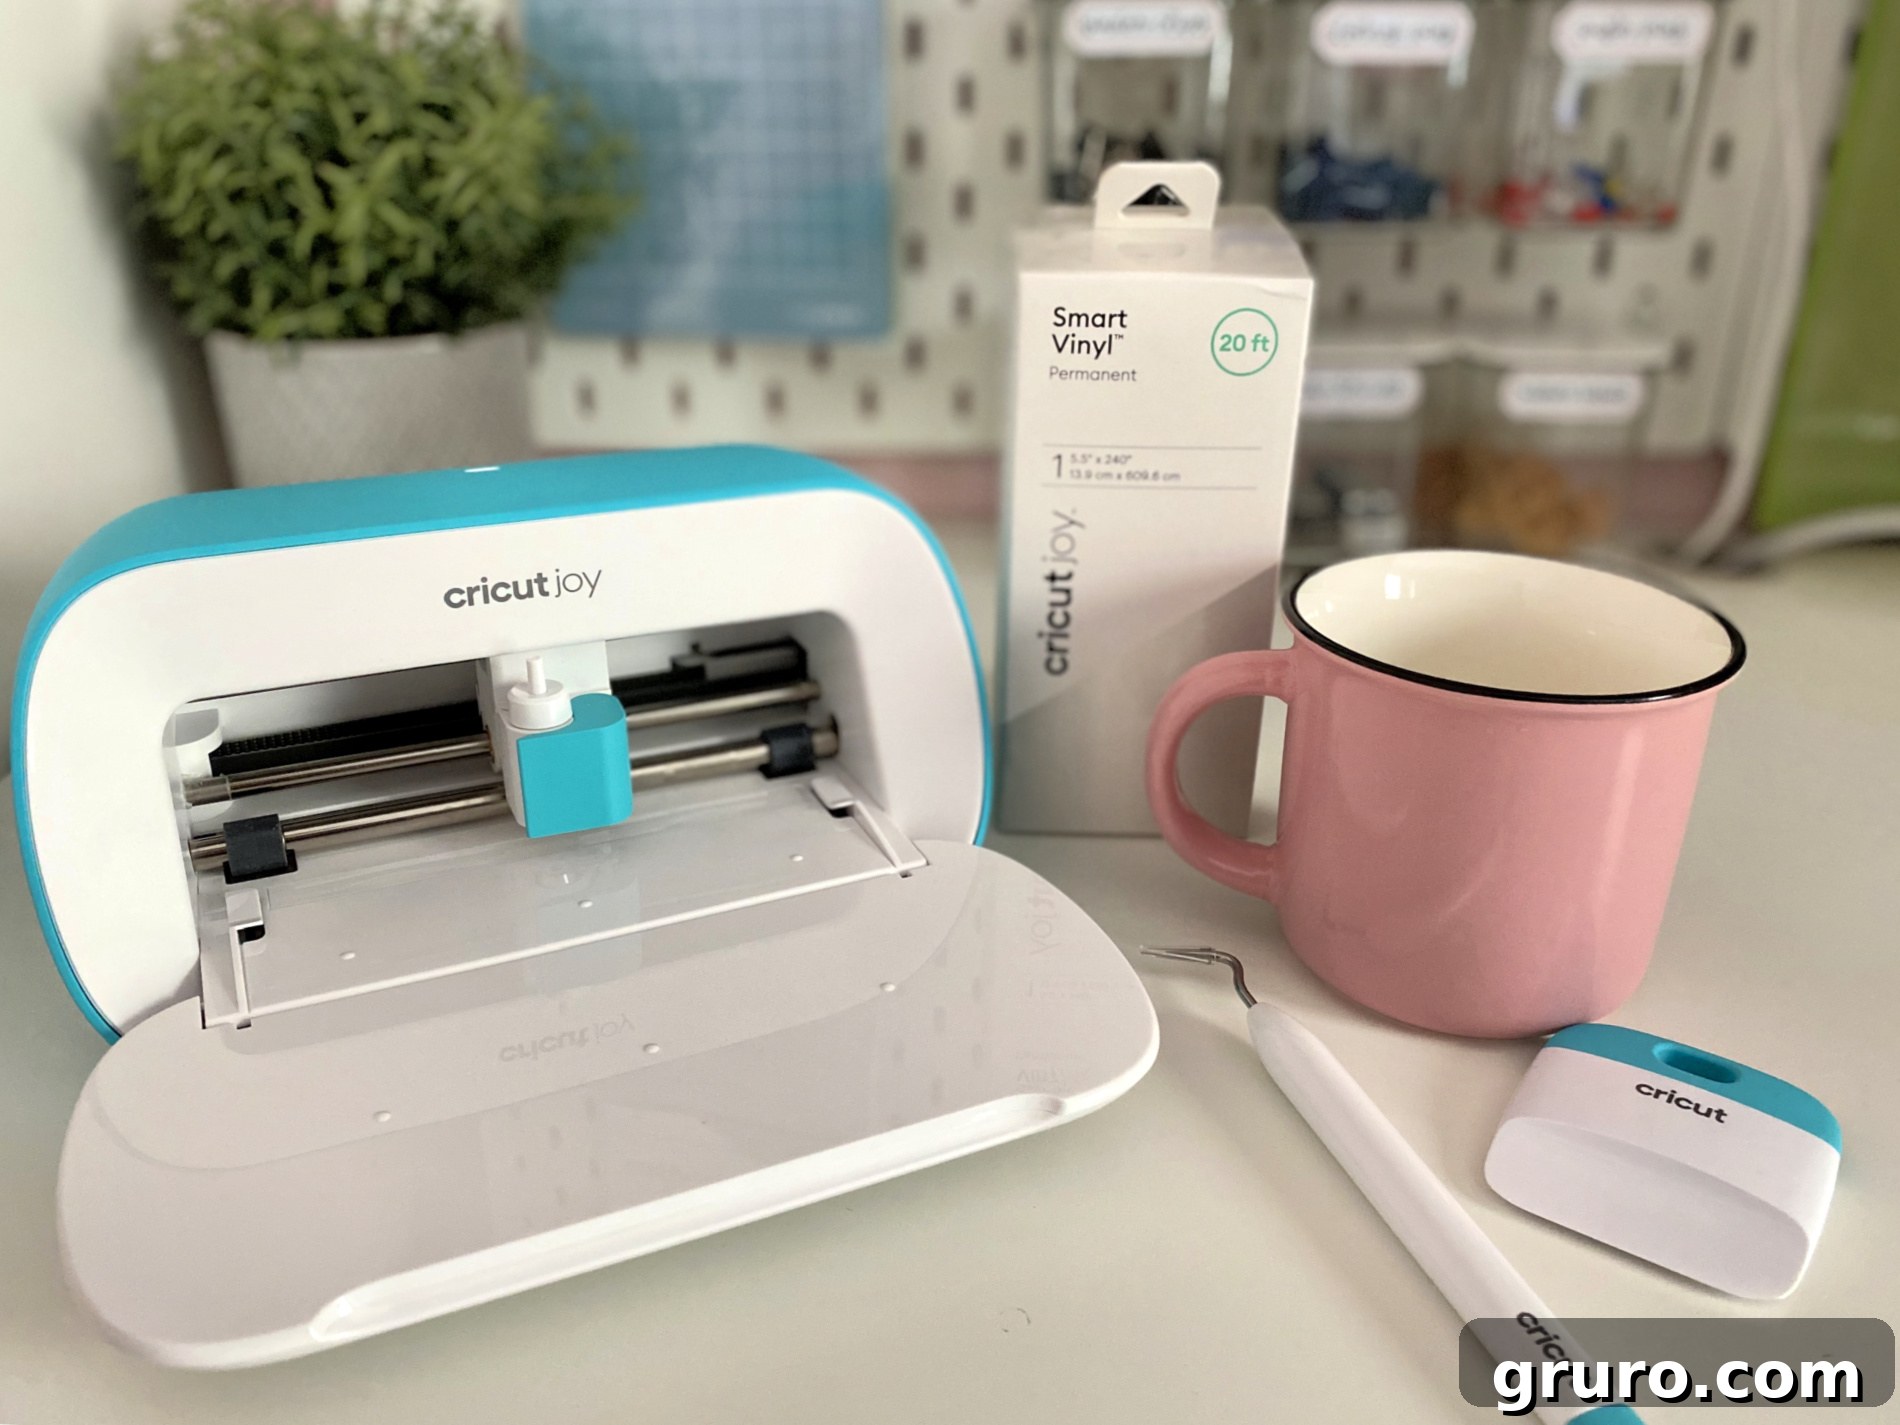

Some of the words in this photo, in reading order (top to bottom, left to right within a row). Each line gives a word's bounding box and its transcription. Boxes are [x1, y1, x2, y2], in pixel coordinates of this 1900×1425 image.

[1053, 306, 1128, 329] Smart
[1219, 333, 1246, 352] 20
[1251, 333, 1270, 352] ft
[1049, 365, 1137, 382] Permanent
[1052, 453, 1062, 479] 1
[1095, 472, 1114, 480] cm
[1163, 473, 1181, 481] cm
[443, 573, 550, 609] cricut
[555, 568, 602, 598] joy
[1037, 570, 1074, 676] cricut
[1634, 1082, 1728, 1124] cricut
